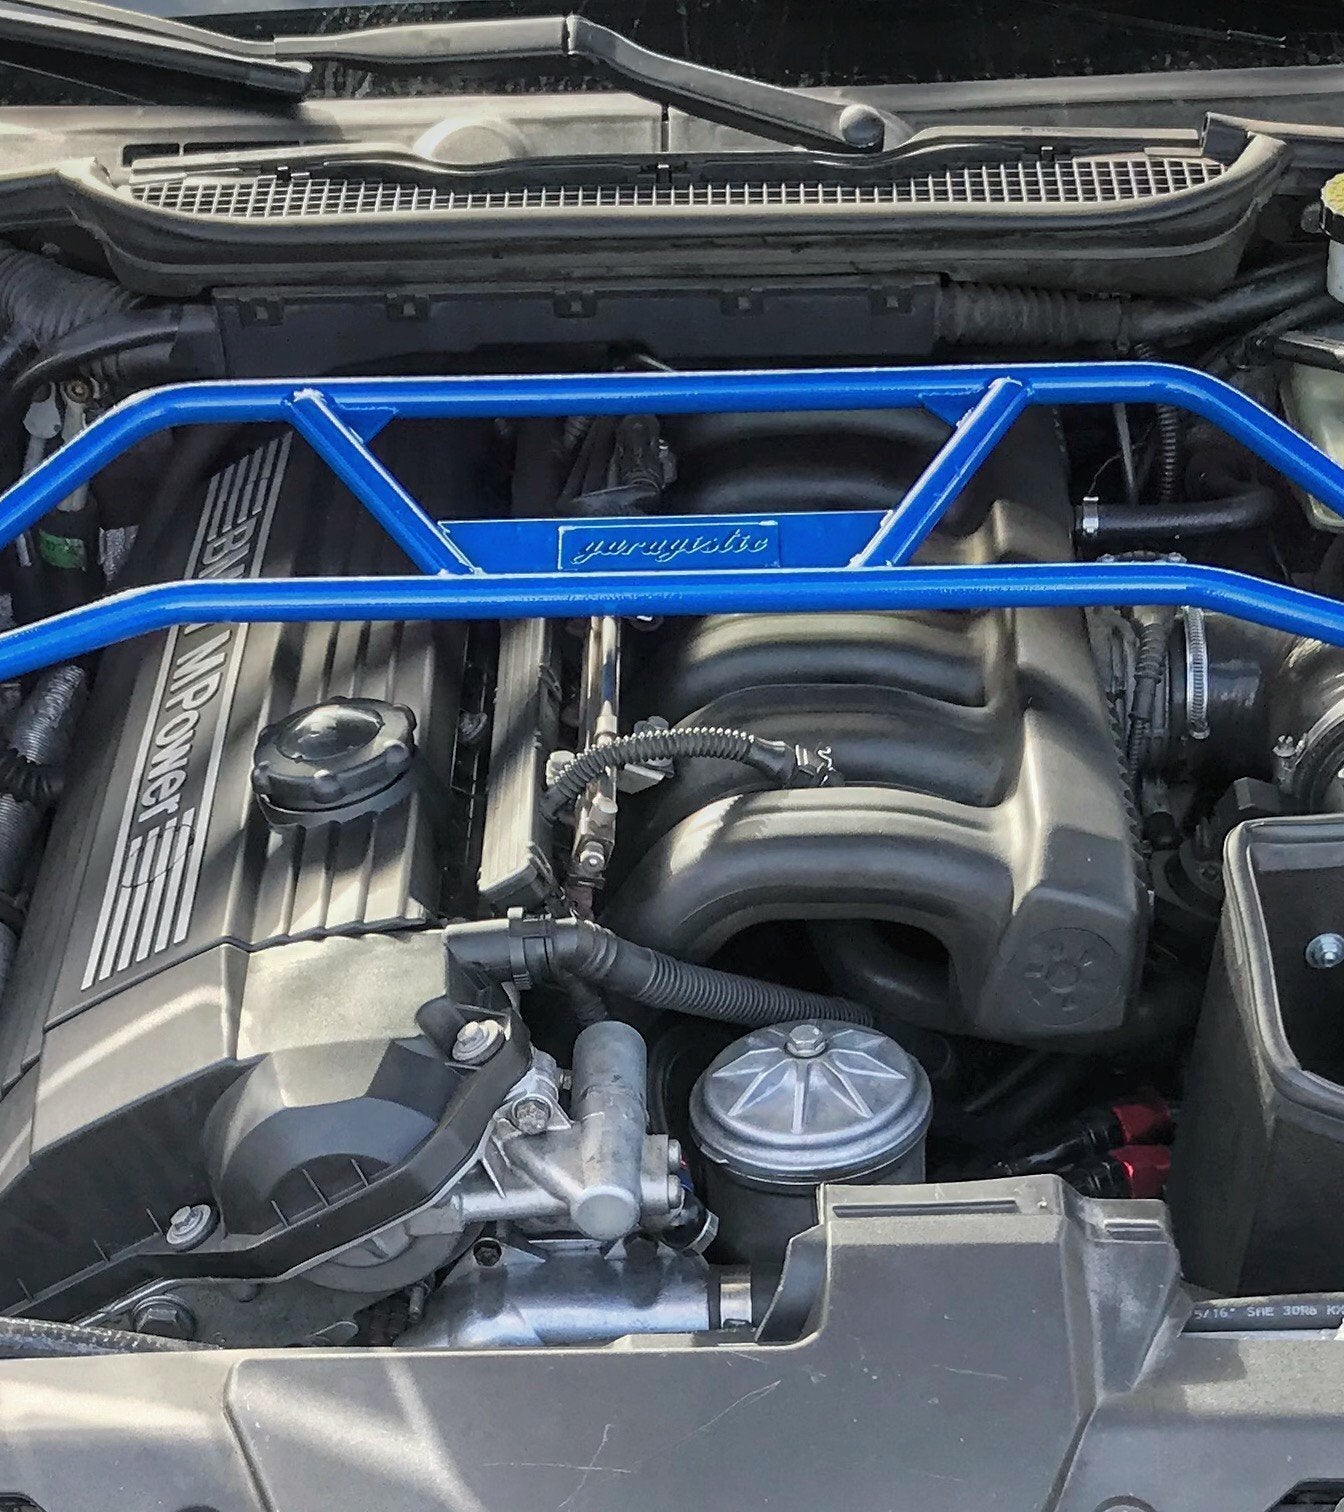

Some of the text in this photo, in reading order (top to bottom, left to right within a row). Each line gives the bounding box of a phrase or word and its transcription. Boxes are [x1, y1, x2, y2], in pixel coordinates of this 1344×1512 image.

[570, 527, 769, 564] garagistic
[138, 630, 230, 823] MPower
[1247, 1306, 1274, 1317] SAE
